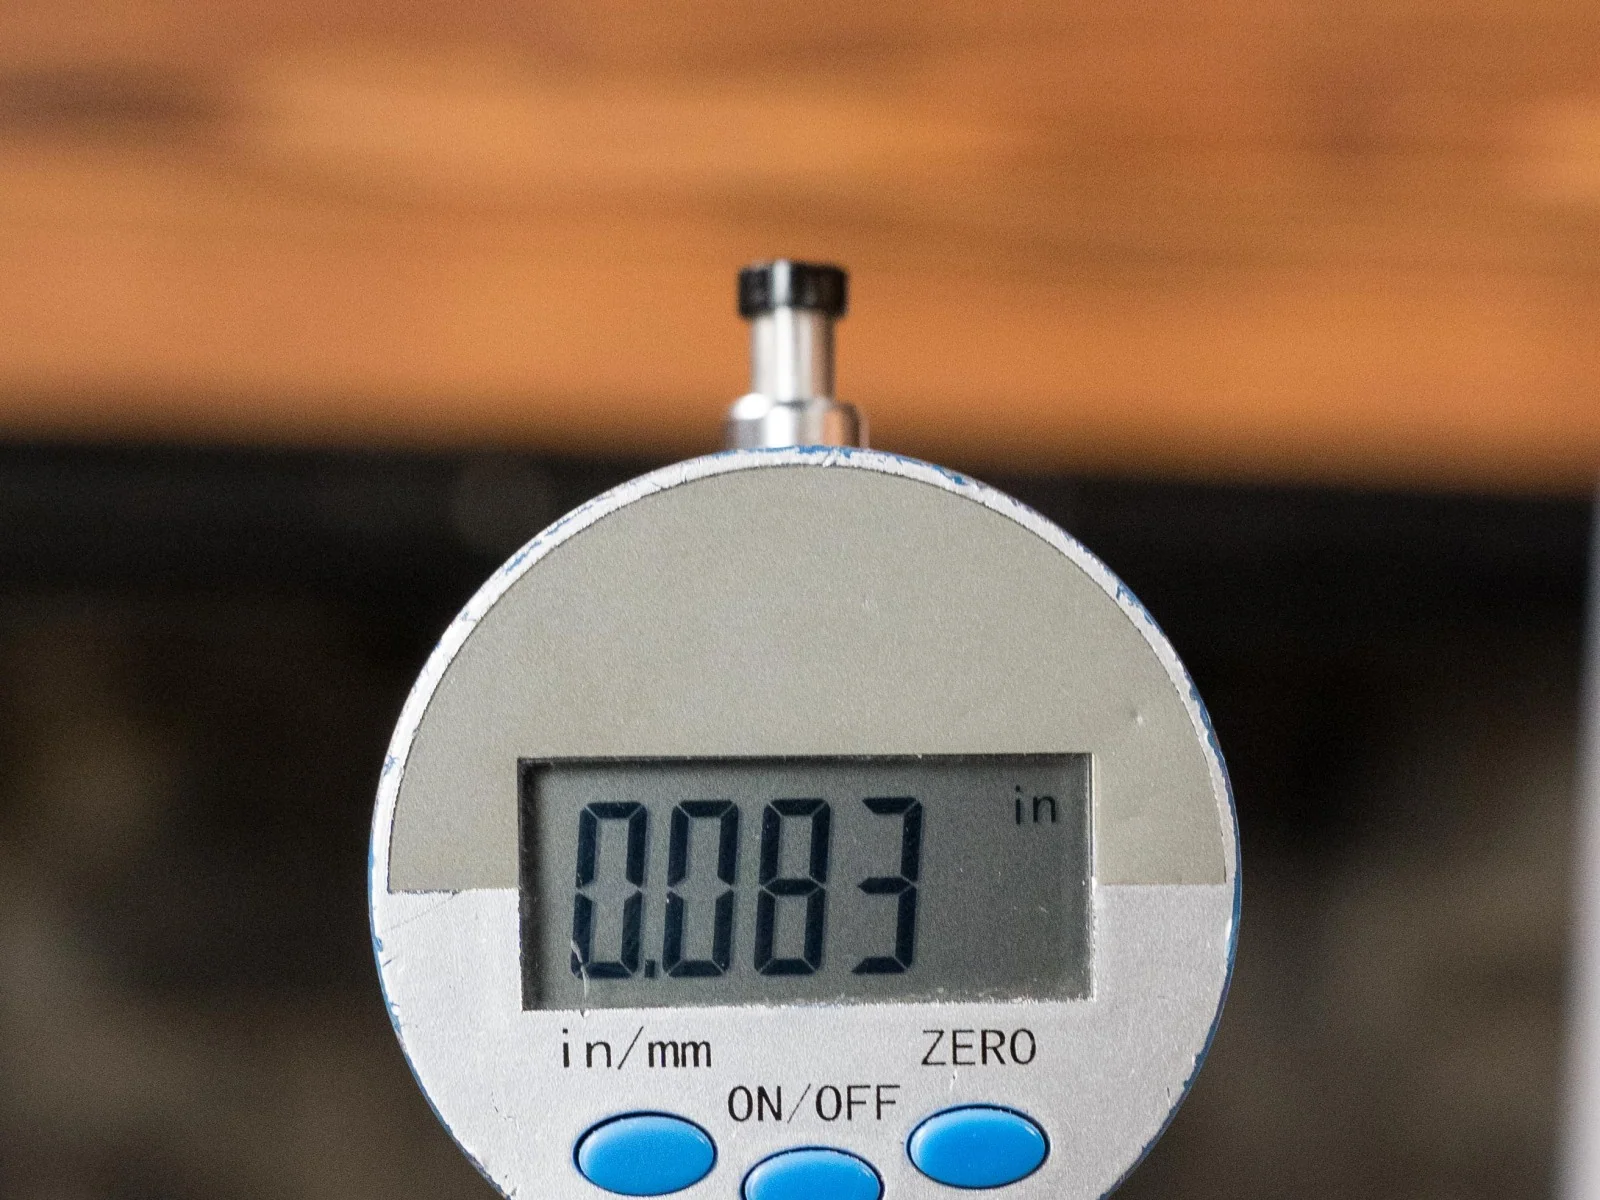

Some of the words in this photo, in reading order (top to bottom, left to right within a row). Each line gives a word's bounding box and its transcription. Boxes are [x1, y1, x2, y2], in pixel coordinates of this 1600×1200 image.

[571, 796, 923, 979] 0.083
[1013, 786, 1058, 825] in
[561, 1026, 713, 1070] in/mm
[920, 1028, 1037, 1066] ZERO
[727, 1084, 901, 1124] ON/OFF
